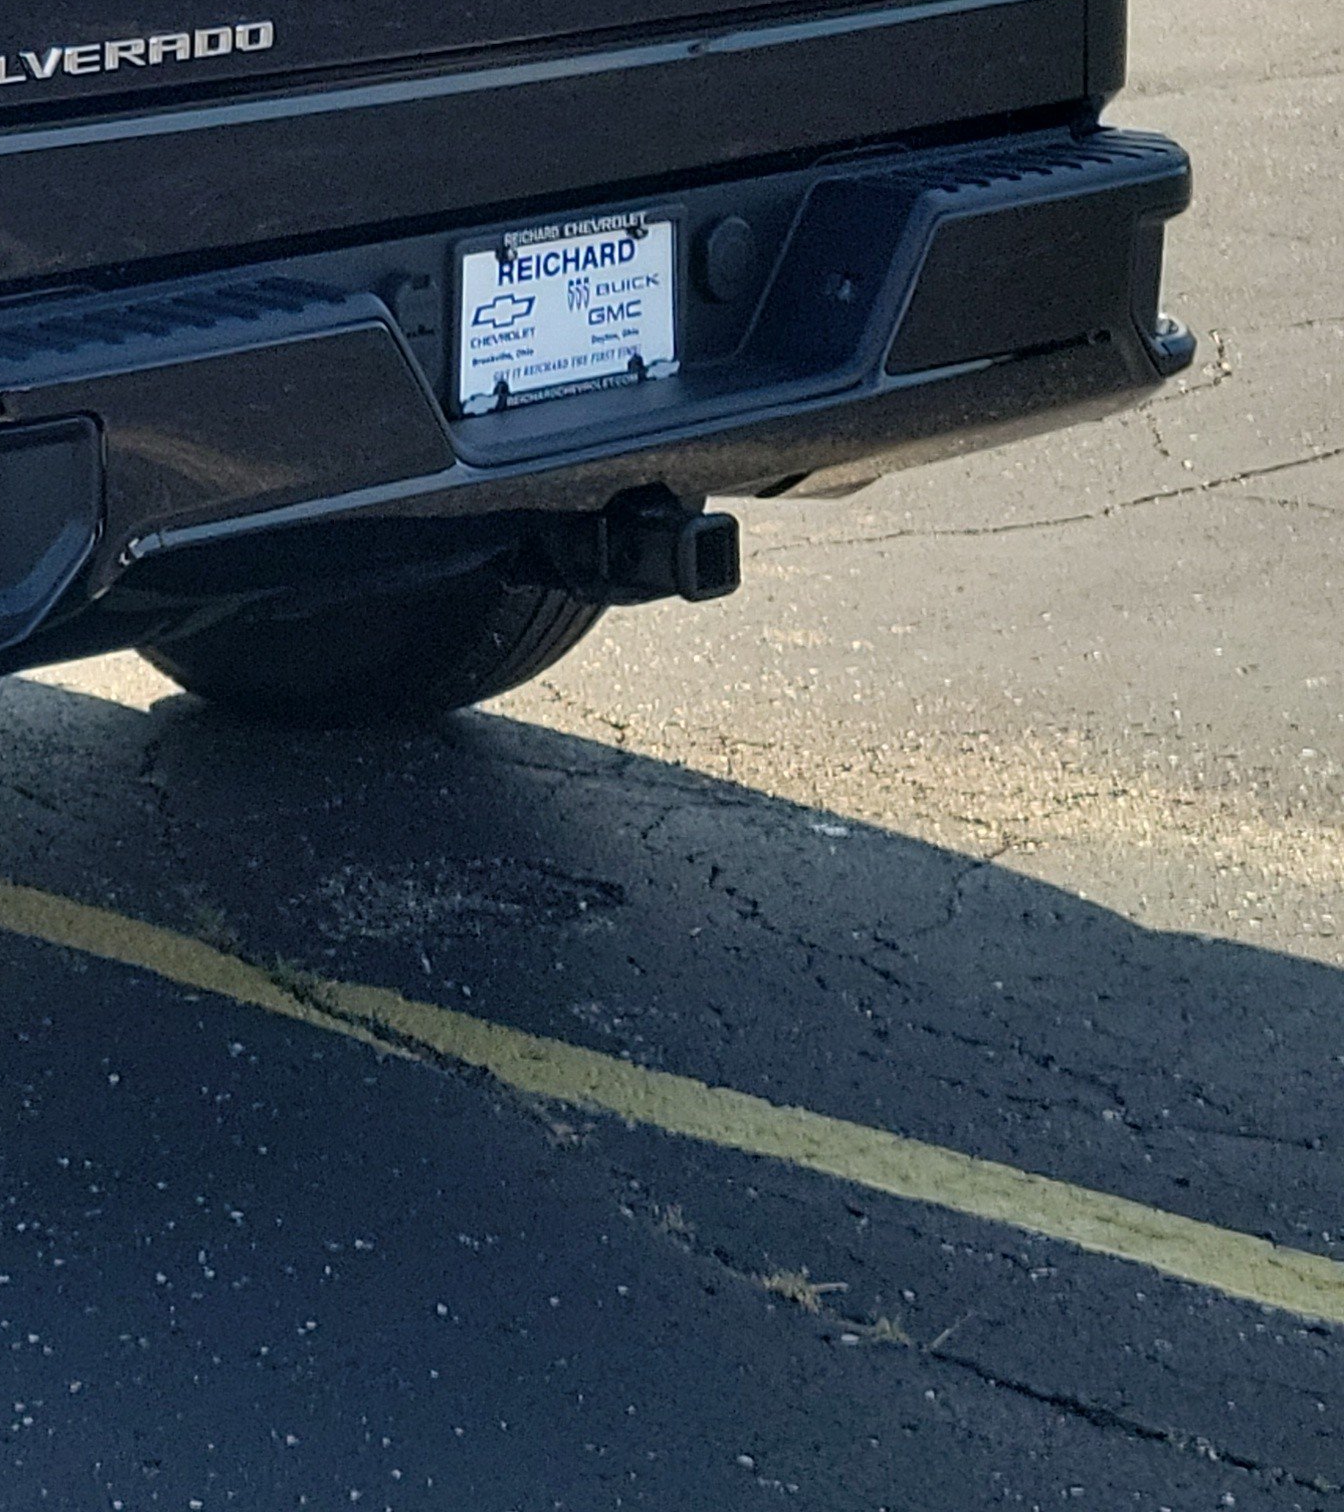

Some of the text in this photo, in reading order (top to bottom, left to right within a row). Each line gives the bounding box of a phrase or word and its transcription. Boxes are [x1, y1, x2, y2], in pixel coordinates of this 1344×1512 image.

[504, 211, 647, 247] REICHARD CHEVROLET
[498, 239, 636, 286] REICHARD
[595, 272, 660, 297] BUICK
[588, 299, 642, 326] GMC
[470, 326, 536, 349] CHEVROLET
